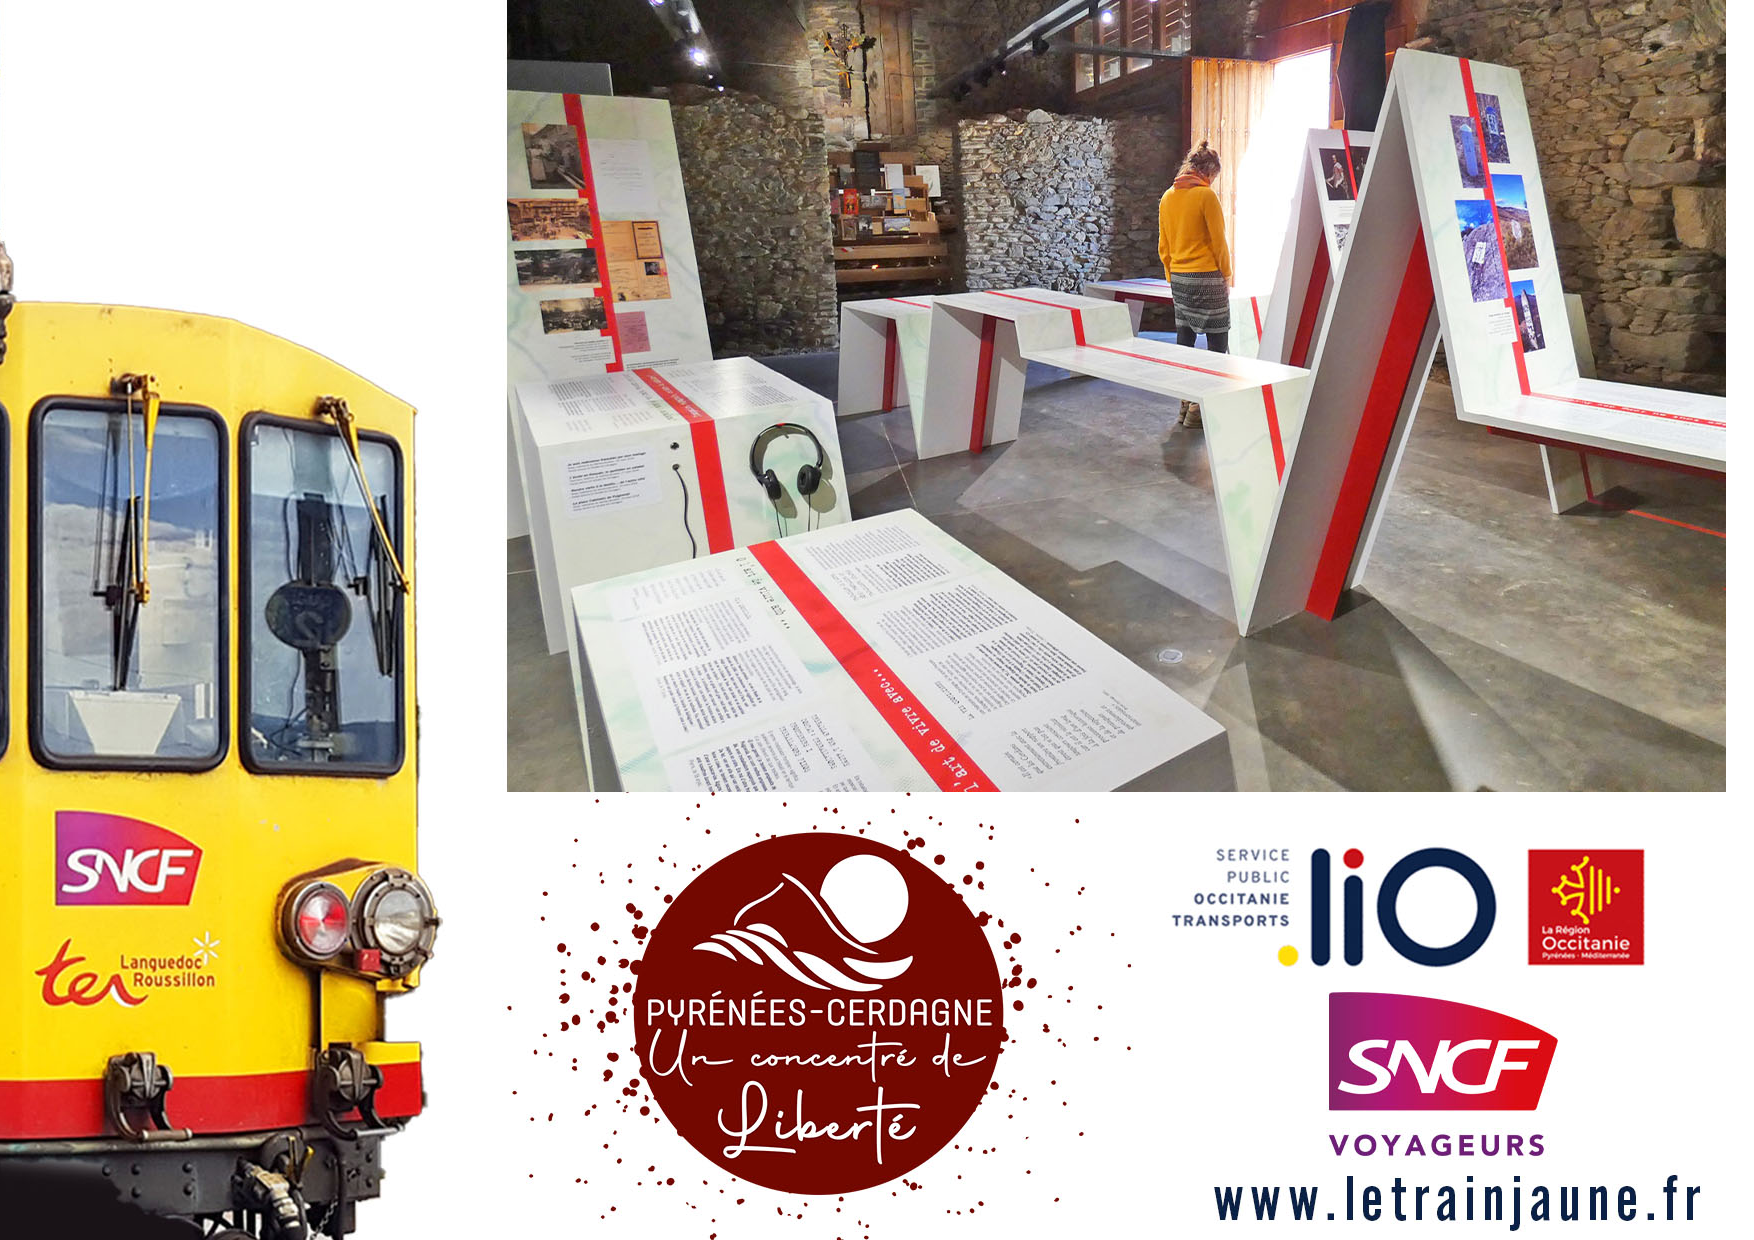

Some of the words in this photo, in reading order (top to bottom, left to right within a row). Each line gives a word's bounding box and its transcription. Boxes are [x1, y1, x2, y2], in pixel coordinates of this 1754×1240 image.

[901, 705, 931, 736] vivre
[929, 738, 946, 753] de
[61, 847, 194, 895] SNCF
[34, 938, 149, 1008] ter
[120, 954, 203, 973] Languedoc
[133, 971, 216, 989] Roussillon
